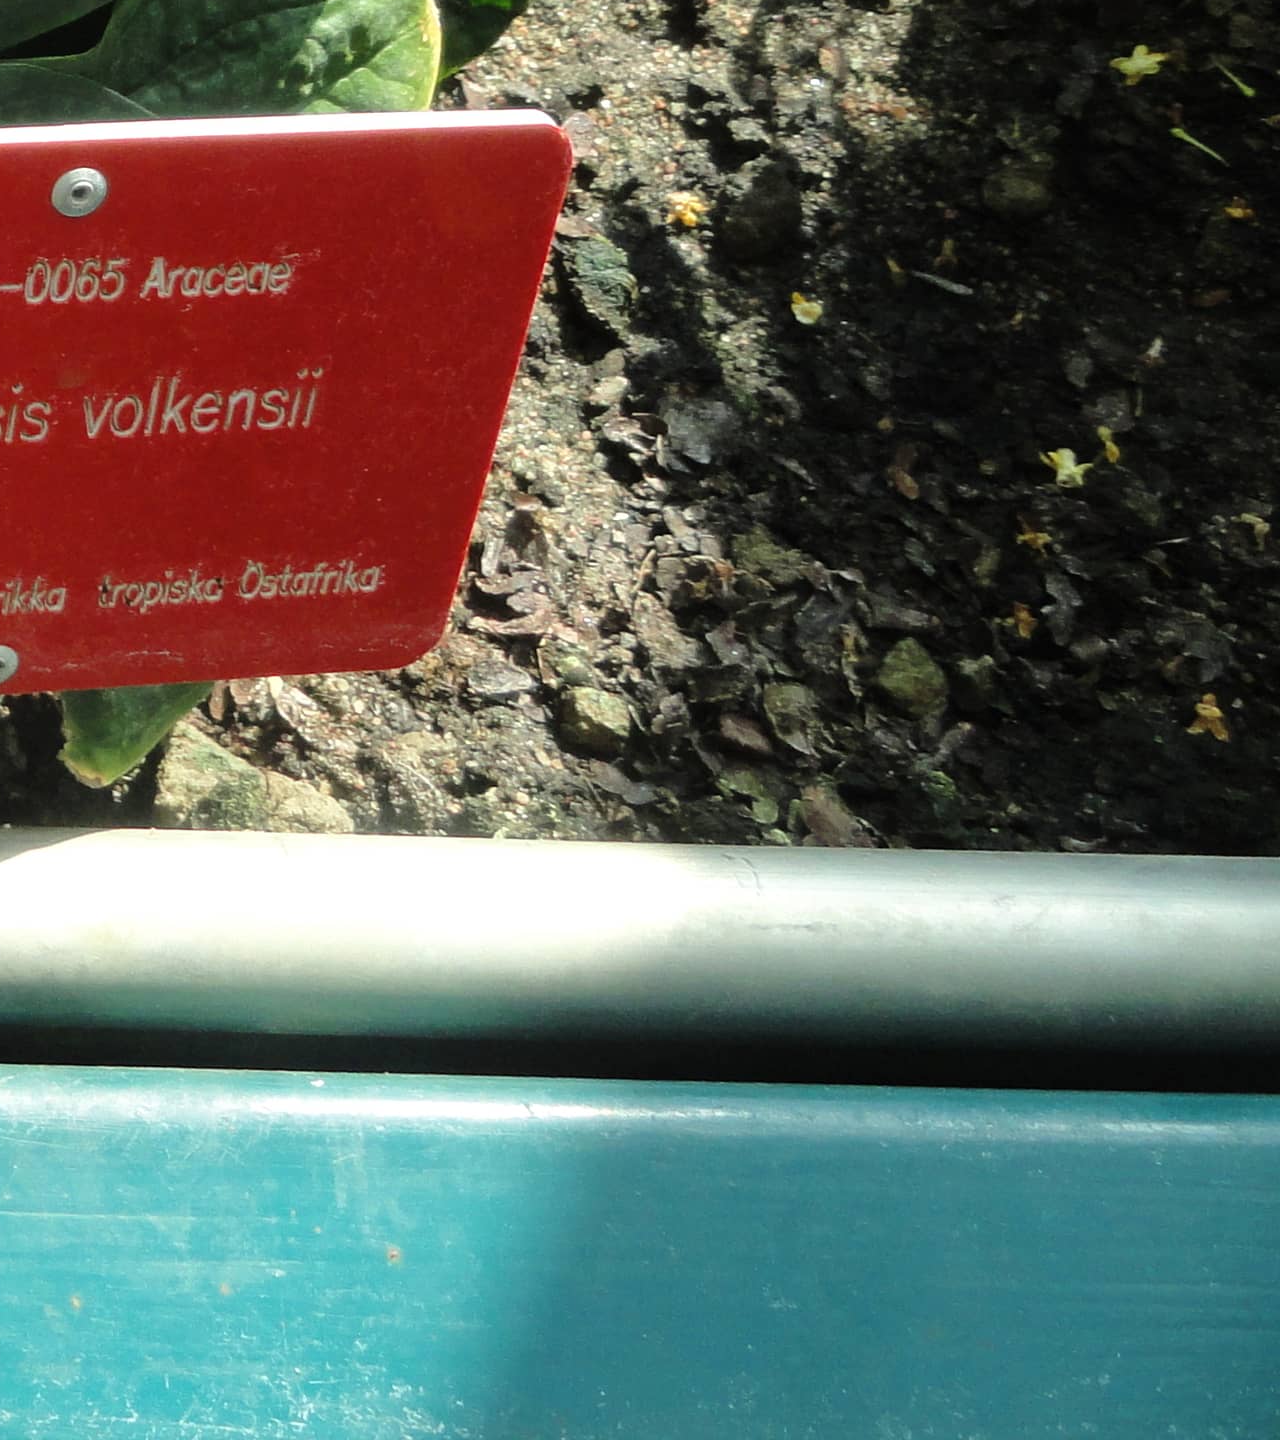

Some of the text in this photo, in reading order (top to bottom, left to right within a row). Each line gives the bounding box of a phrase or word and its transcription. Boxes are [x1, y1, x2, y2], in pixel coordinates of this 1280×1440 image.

[141, 258, 292, 298] Araceae
[83, 366, 324, 440] volkensii
[97, 570, 226, 614] tropiska
[237, 559, 382, 600] Östafrika
